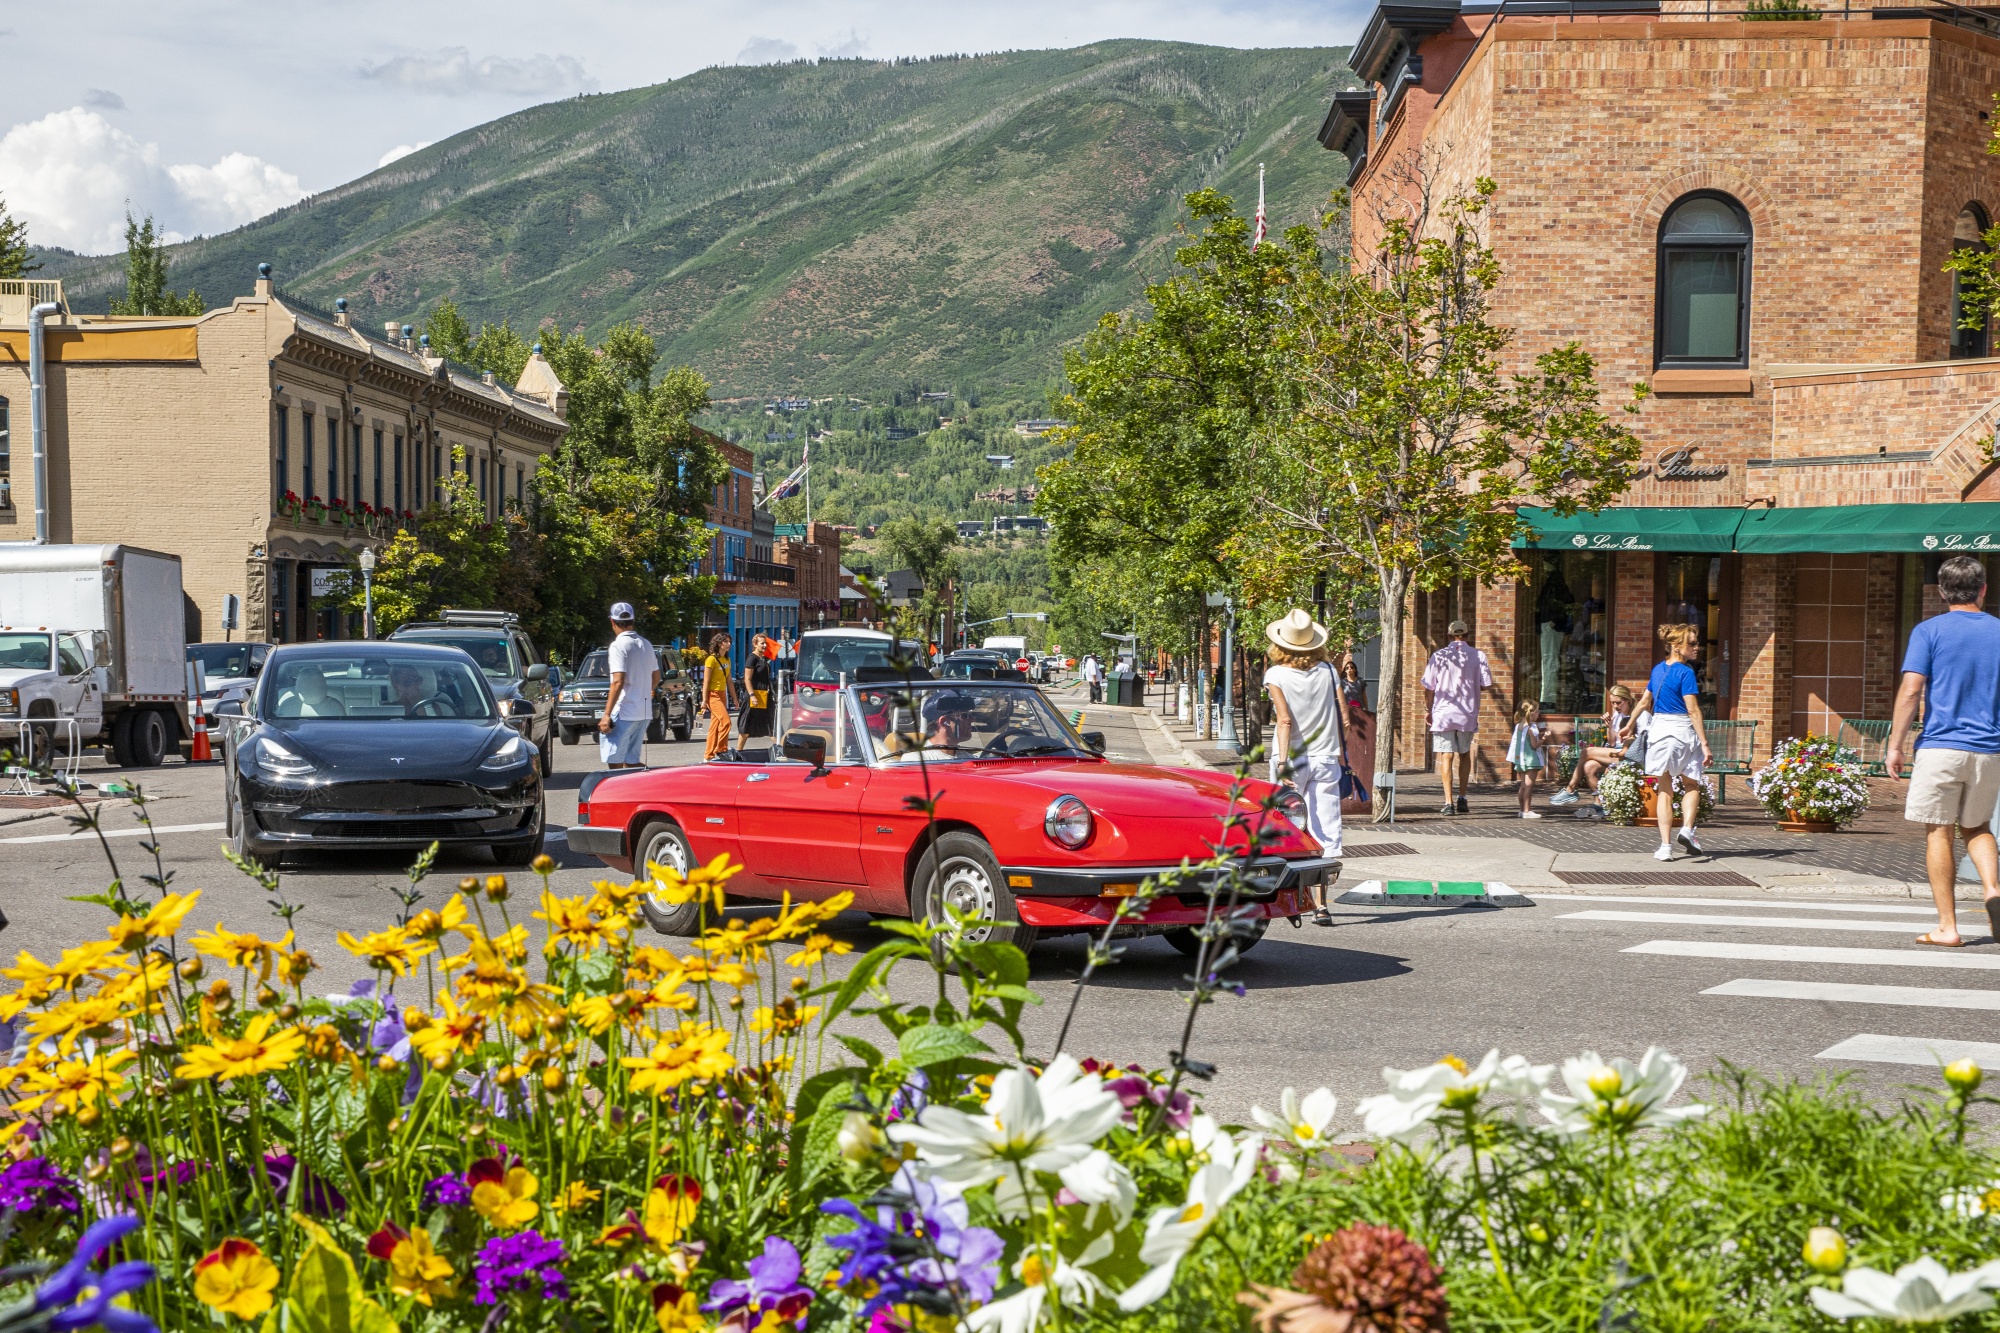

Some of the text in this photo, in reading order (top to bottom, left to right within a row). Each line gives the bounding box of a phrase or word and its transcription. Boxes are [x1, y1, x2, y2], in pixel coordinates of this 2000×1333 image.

[1652, 439, 1725, 477] Piana
[1588, 534, 1653, 550] Loro Piana
[1939, 535, 1971, 550] Loro
